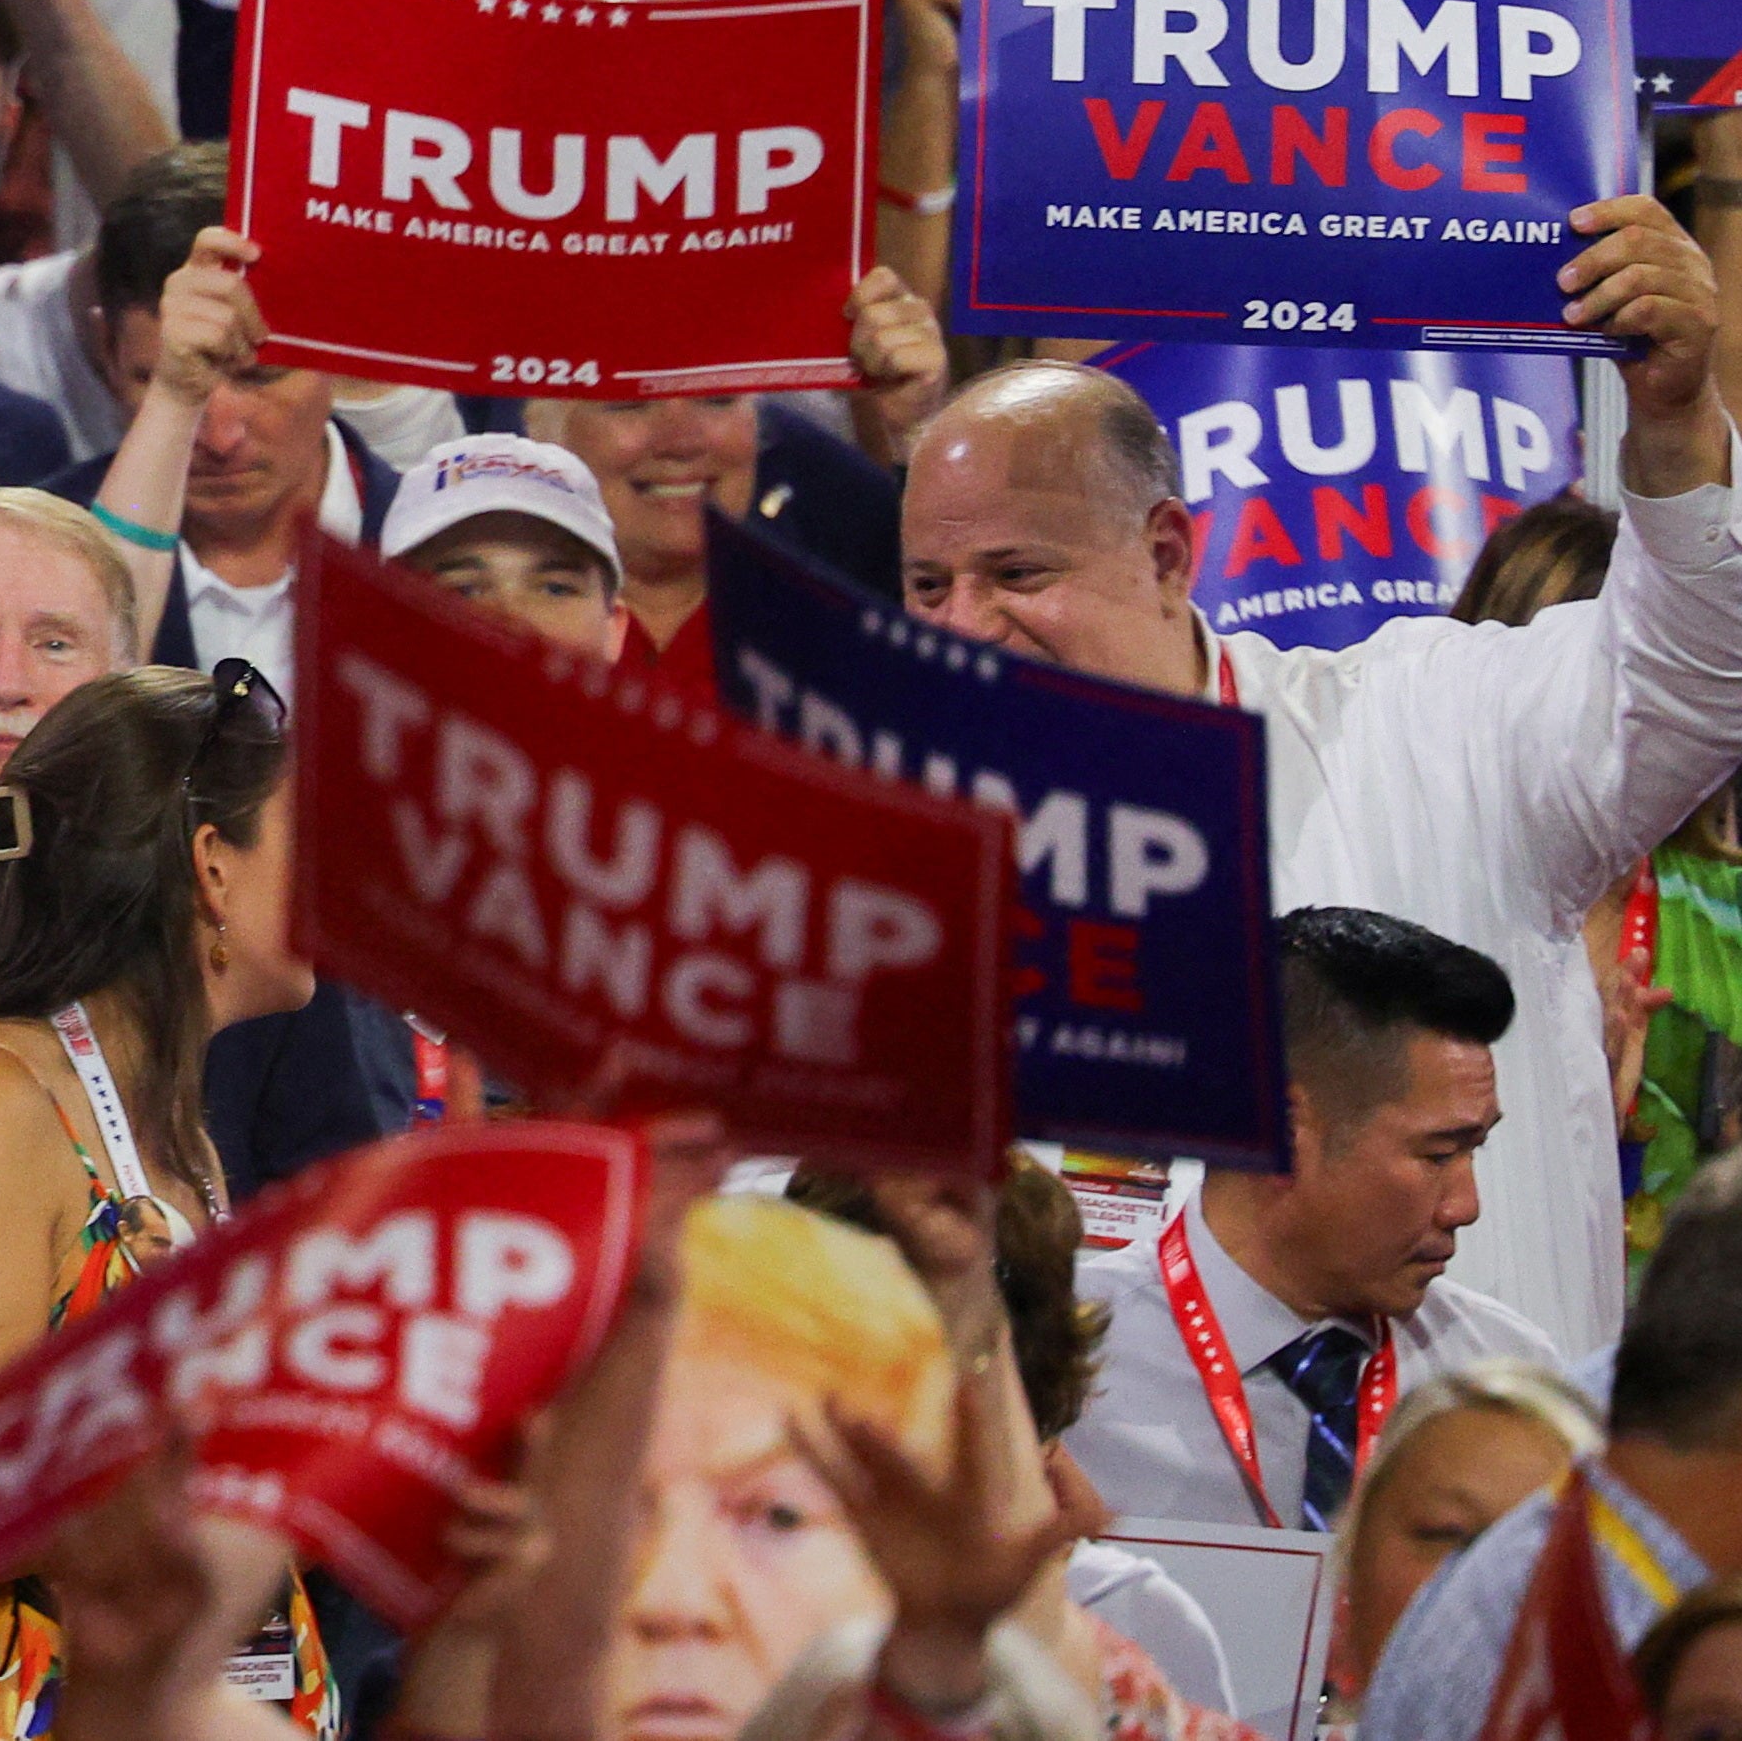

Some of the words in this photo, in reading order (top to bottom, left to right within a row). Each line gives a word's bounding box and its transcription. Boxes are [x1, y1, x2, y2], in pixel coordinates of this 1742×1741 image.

[286, 87, 825, 223] TRUMP
[1083, 97, 1528, 194] VANCE
[305, 196, 393, 235] MAKE
[403, 216, 551, 254] AMERICA
[562, 231, 667, 256] GREAT
[679, 222, 793, 253] AGAIN!
[1045, 203, 1142, 232] MAKE
[1152, 207, 1307, 238] AMERICA
[1318, 213, 1432, 243] GREAT
[1441, 216, 1562, 246] AGAIN!
[1242, 299, 1357, 335] 2024
[490, 356, 600, 388] 2024
[1159, 379, 1552, 504] RUMP
[1217, 581, 1365, 628] AMERICA
[1372, 578, 1463, 607] GREA
[335, 652, 944, 980] TRUMP
[393, 798, 863, 1062] VANCE
